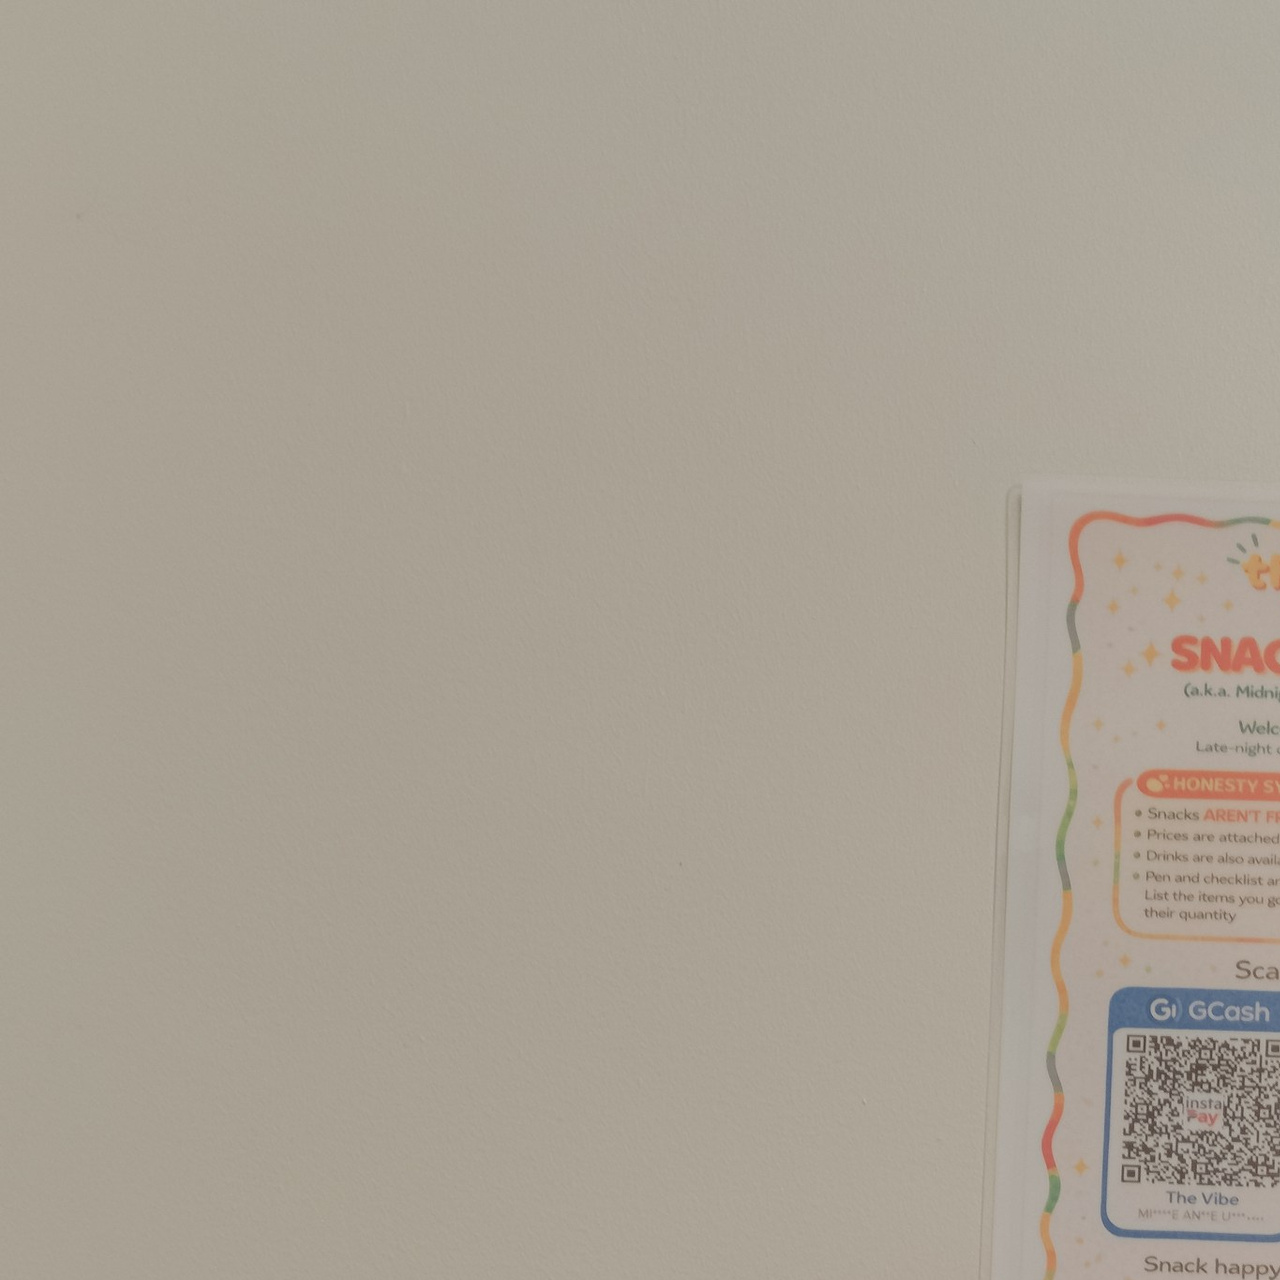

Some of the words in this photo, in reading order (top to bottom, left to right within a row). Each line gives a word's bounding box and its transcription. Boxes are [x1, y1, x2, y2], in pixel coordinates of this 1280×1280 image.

[1183, 683, 1230, 699] (a.k.a.
[1195, 741, 1272, 758] Late-night
[1173, 778, 1259, 794] HONESTY
[1148, 807, 1199, 822] Snacks
[1204, 808, 1261, 824] AREN'T
[1146, 829, 1189, 843] Prices
[1193, 832, 1214, 844] are
[1219, 832, 1280, 846] attached
[1146, 851, 1189, 863] Drinks
[1193, 852, 1214, 863] are
[1217, 851, 1243, 865] also
[1145, 871, 1170, 884] Pen
[1175, 871, 1198, 885] and
[1203, 872, 1263, 886] checklist
[1144, 890, 1169, 902] List
[1172, 890, 1194, 902] the
[1198, 891, 1234, 904] items
[1238, 895, 1262, 909] you
[1144, 907, 1175, 921] their
[1179, 908, 1236, 924] quantity
[1189, 1001, 1270, 1022] GCash
[1166, 1191, 1198, 1206] The
[1201, 1192, 1239, 1207] Vibe
[1144, 1256, 1208, 1275] Snack
